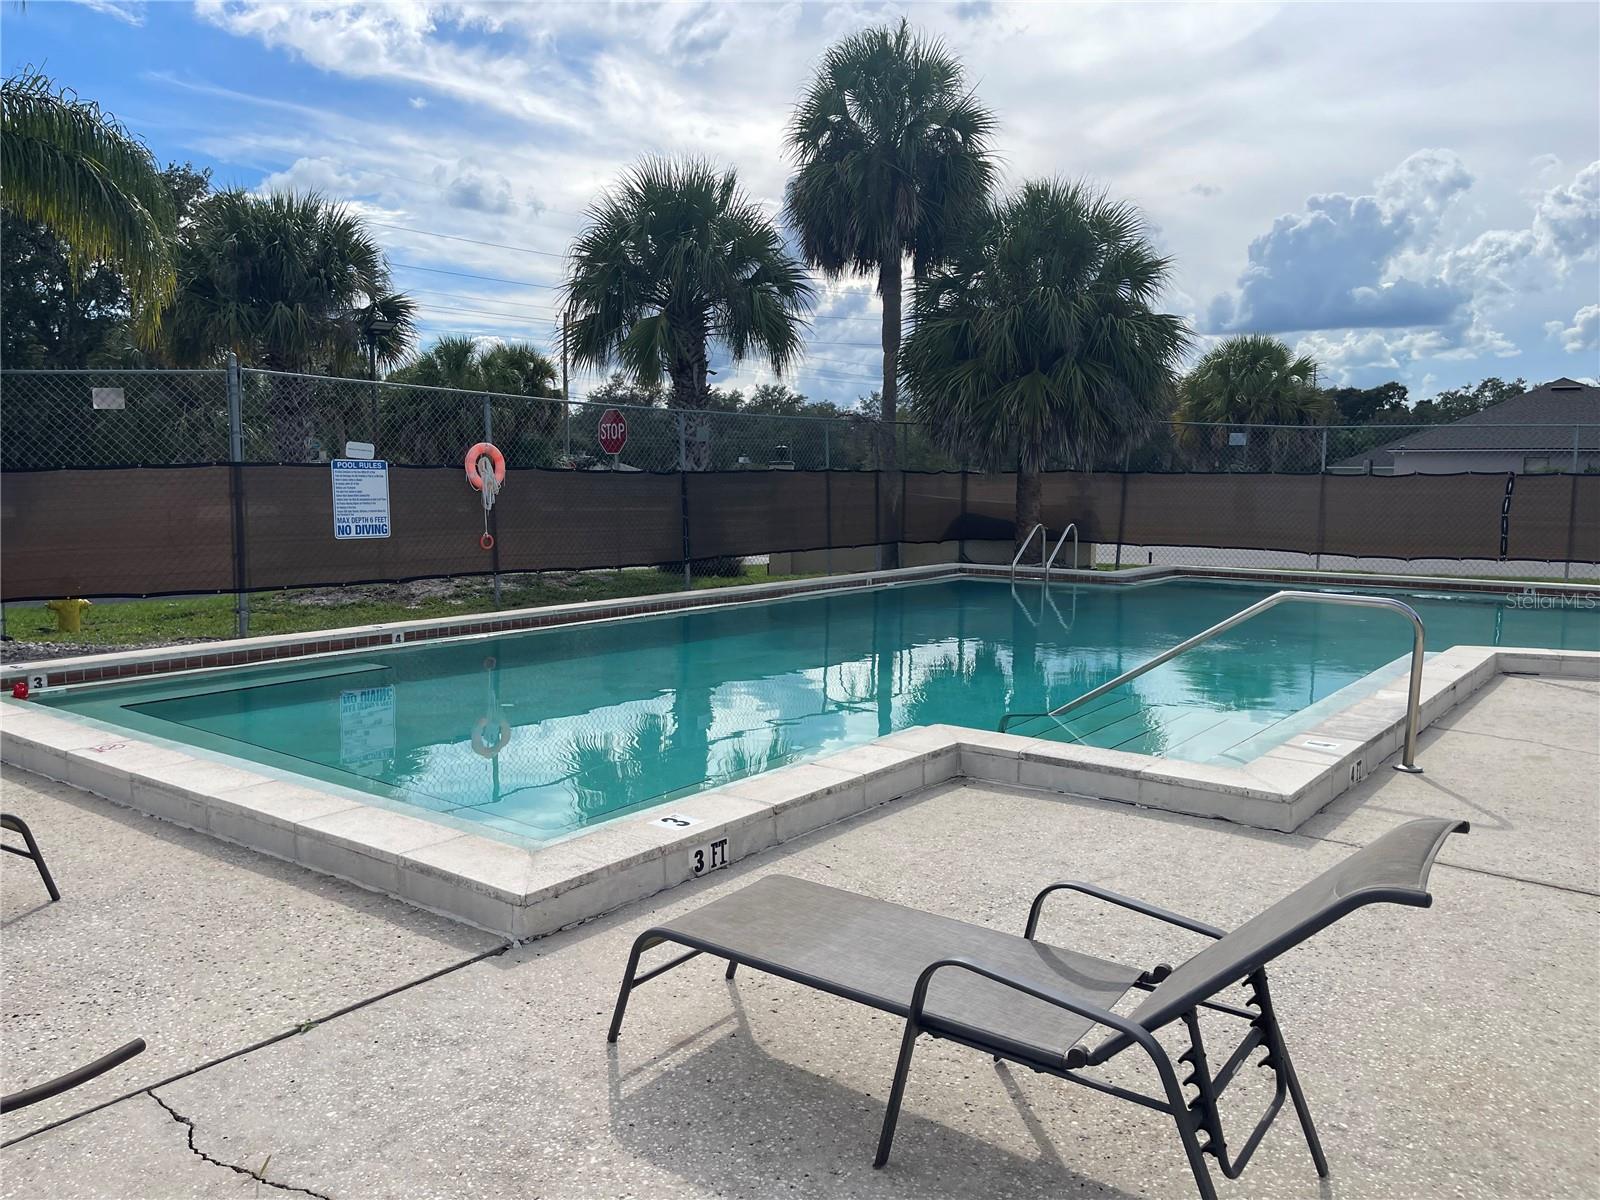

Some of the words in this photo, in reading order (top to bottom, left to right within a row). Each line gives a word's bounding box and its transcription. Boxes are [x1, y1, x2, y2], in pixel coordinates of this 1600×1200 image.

[600, 423, 625, 440] STOP
[337, 524, 352, 536] NO
[355, 523, 388, 535] DIVING
[395, 633, 401, 643] 4
[33, 677, 43, 689] 3
[693, 849, 705, 873] 3
[710, 838, 728, 869] FT
